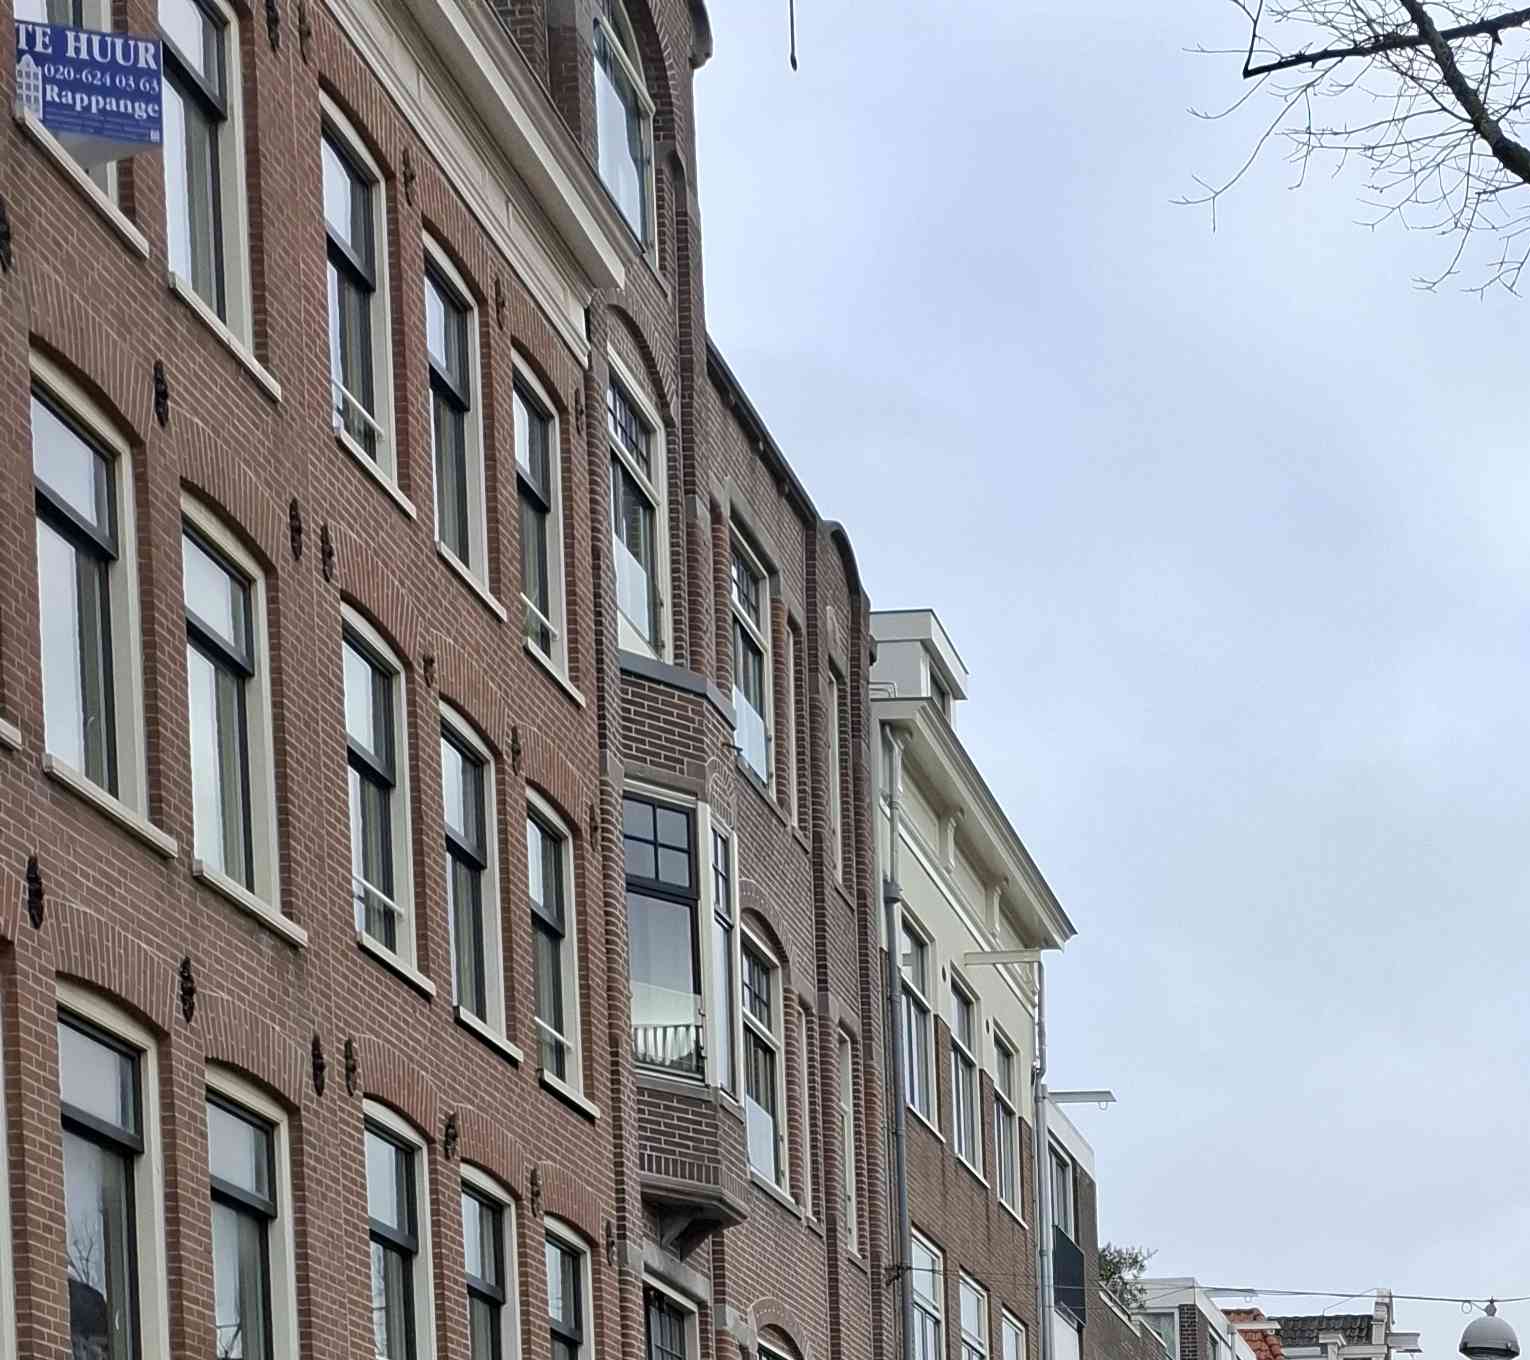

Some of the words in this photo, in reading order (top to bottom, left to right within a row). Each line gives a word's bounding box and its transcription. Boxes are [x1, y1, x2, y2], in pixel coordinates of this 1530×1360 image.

[15, 23, 52, 54] TE
[65, 30, 158, 70] HUUR
[44, 63, 111, 88] 020-624
[45, 84, 160, 120] Rappange
